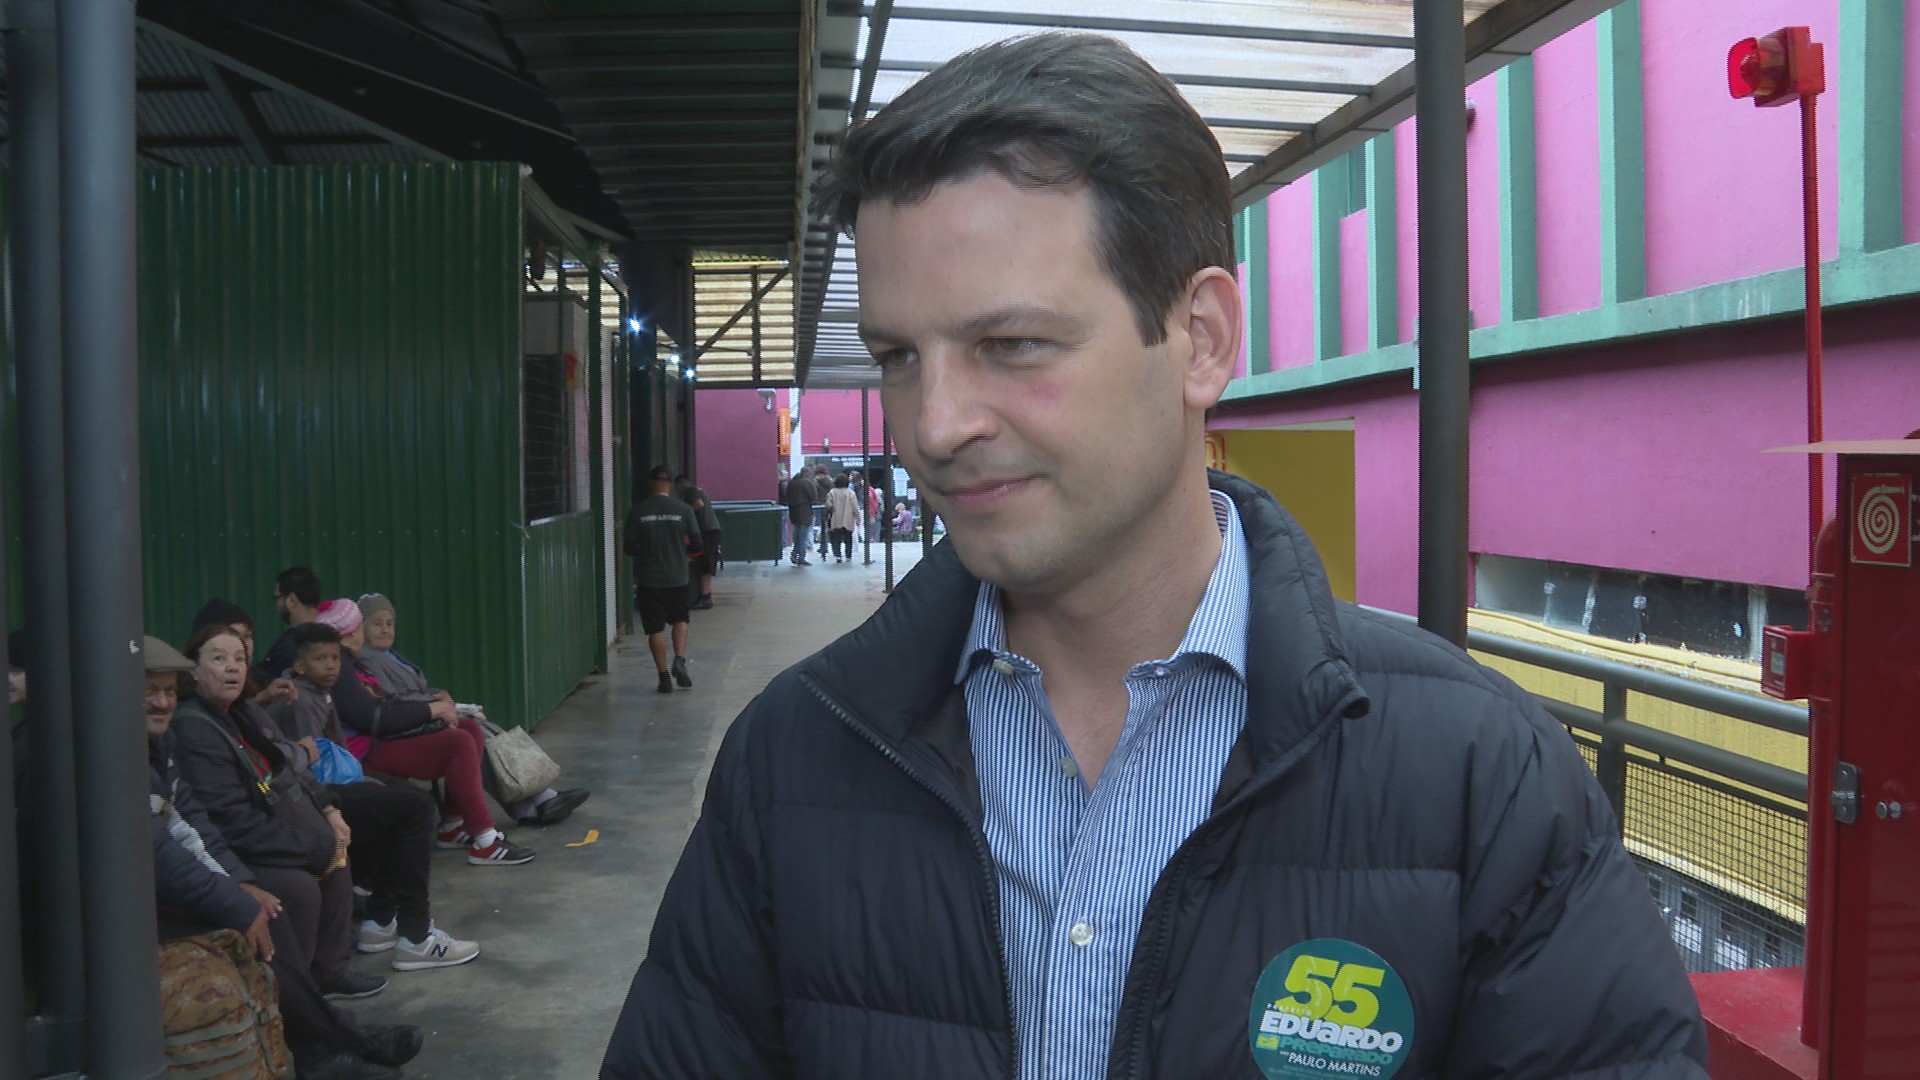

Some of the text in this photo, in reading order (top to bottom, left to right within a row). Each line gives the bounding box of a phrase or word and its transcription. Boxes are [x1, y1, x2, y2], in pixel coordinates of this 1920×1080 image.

[431, 944, 448, 958] N
[1274, 954, 1386, 1029] 55
[1288, 1052, 1327, 1070] PAULO
[1327, 1061, 1382, 1077] MARTINS
